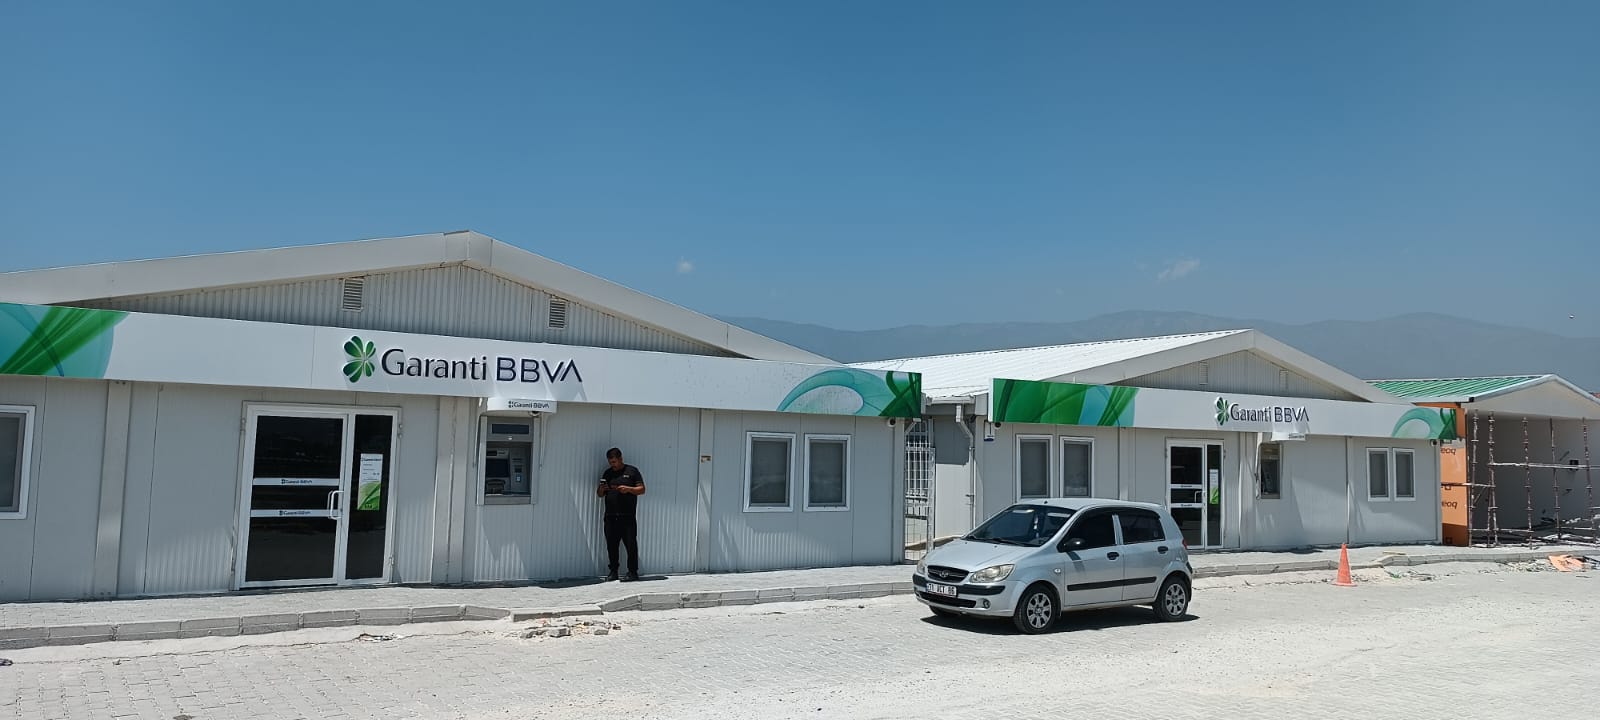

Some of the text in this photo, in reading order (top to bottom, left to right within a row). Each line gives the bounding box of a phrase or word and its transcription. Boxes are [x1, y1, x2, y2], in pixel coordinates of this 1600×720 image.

[381, 348, 582, 383] Garanti BBVA
[1230, 403, 1310, 423] Garanti BBVA
